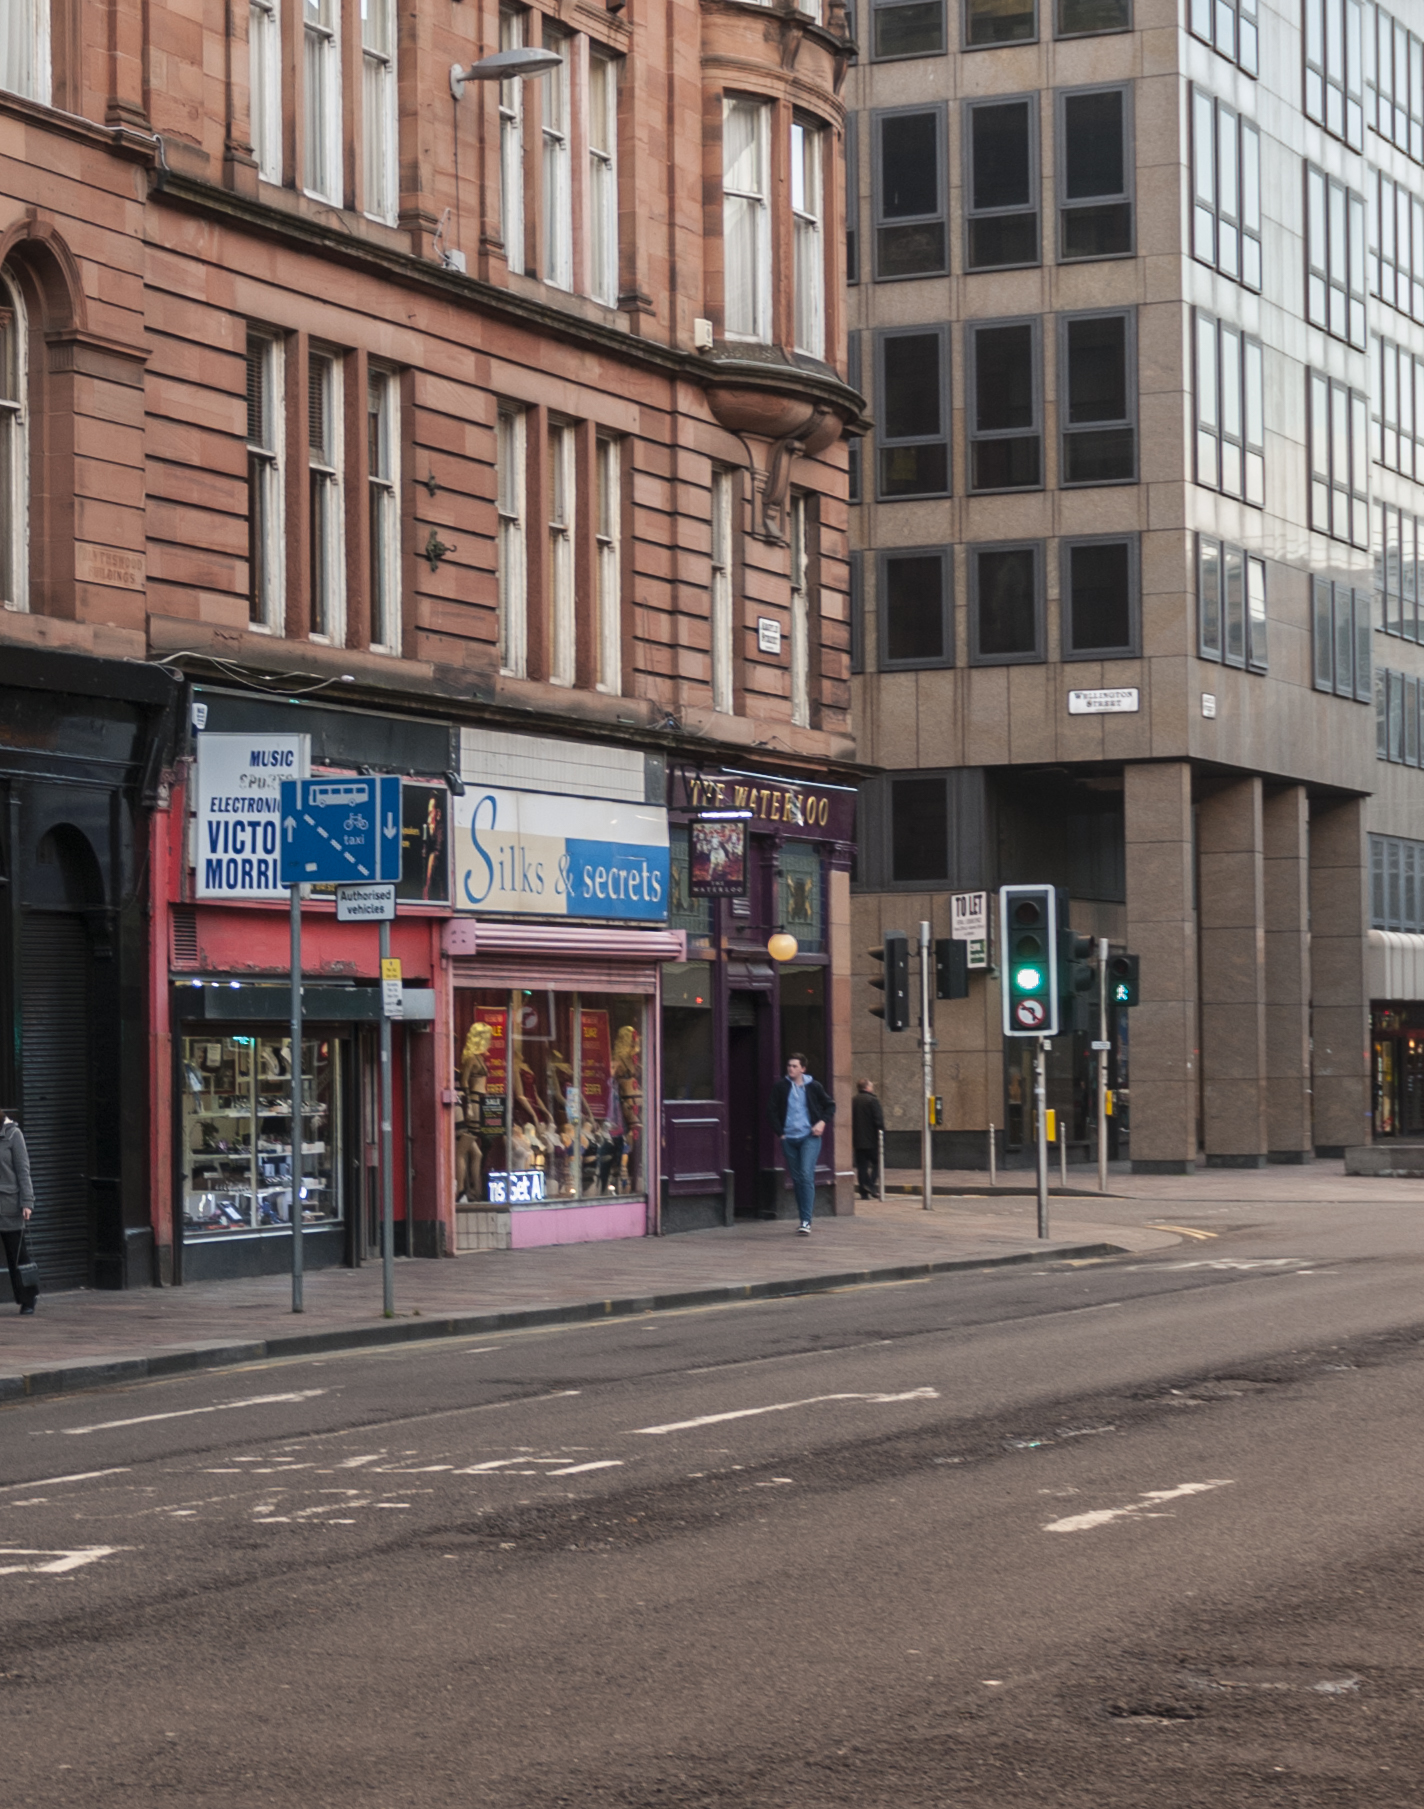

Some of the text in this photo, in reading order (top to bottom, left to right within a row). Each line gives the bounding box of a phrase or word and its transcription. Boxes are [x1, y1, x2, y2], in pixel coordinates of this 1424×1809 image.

[249, 750, 294, 767] MUSIC
[734, 785, 829, 826] WATERLOO
[207, 820, 277, 854] VICTO
[344, 834, 365, 845] taxi
[464, 795, 662, 904] Silks & secrets
[205, 857, 291, 890] MORRI
[340, 889, 392, 902] Authorised
[955, 894, 983, 918] TO LET
[346, 903, 385, 915] vehicles
